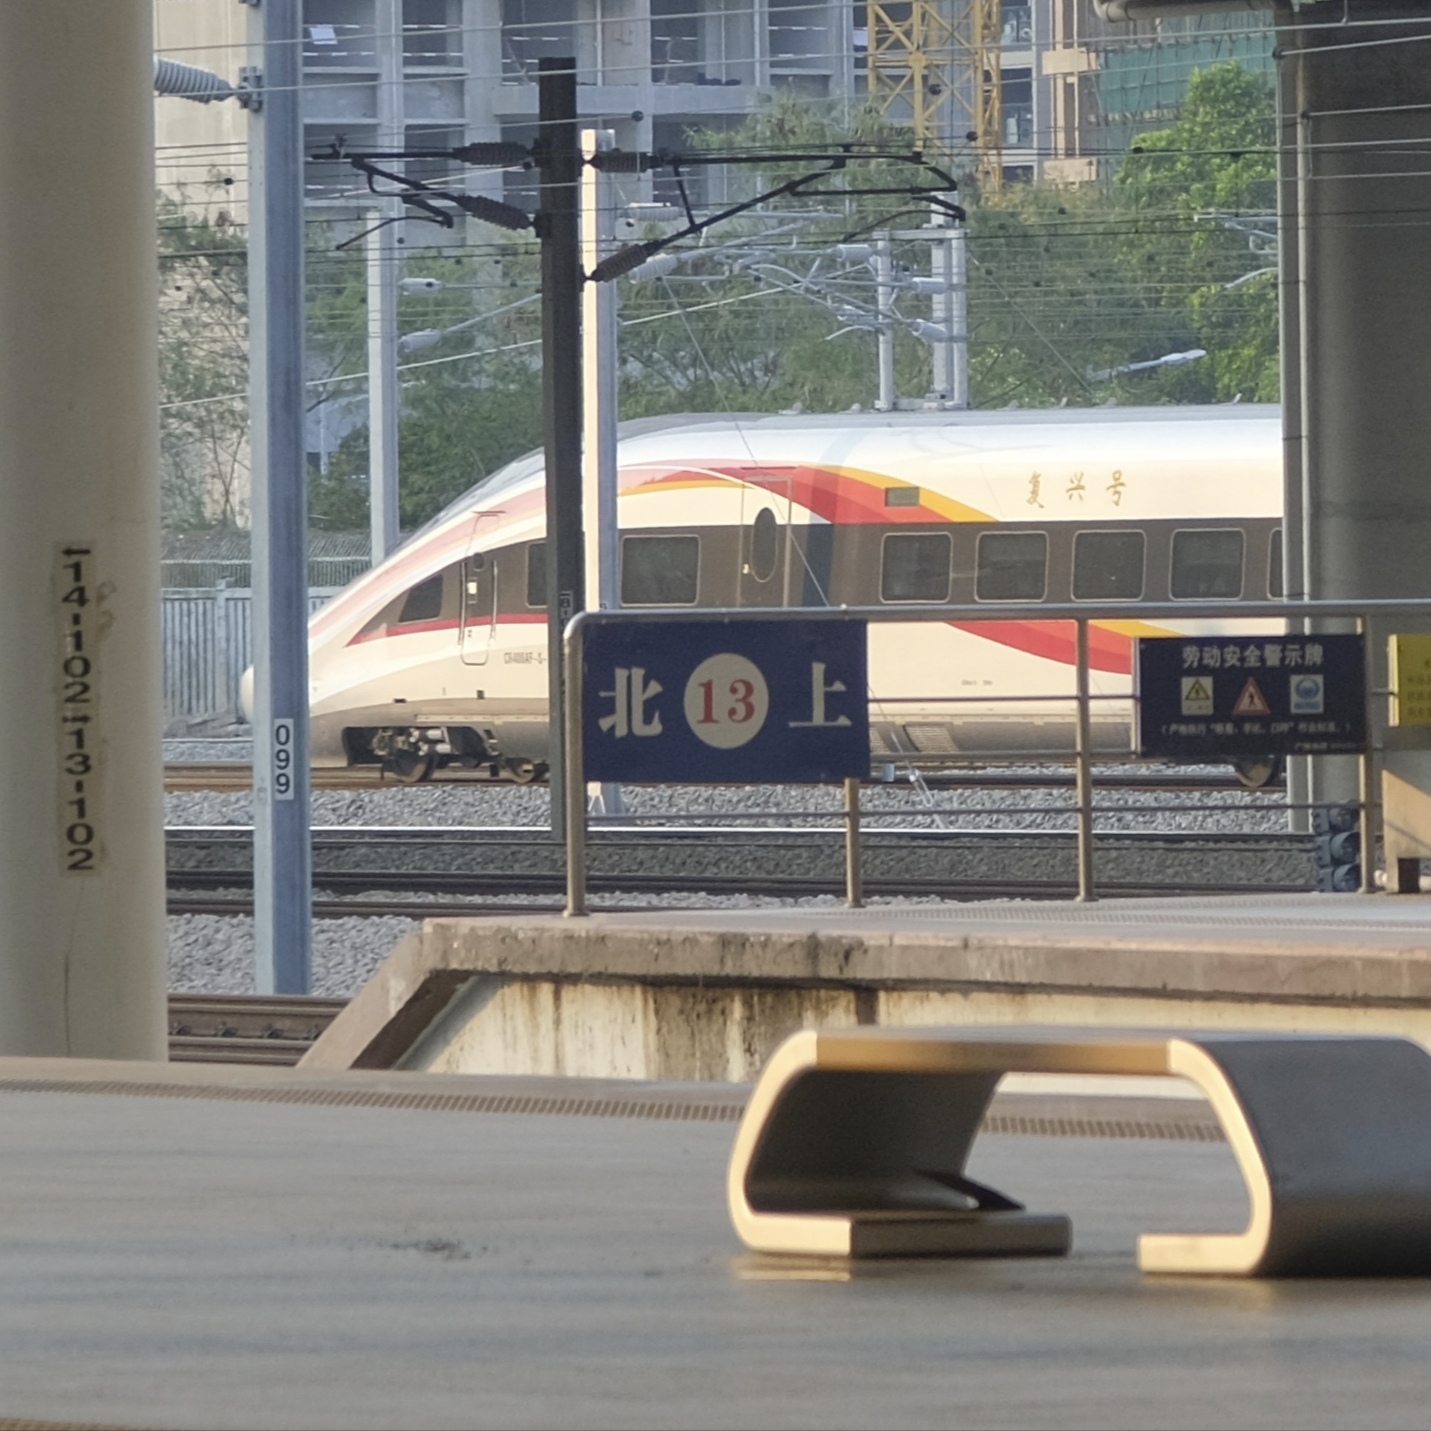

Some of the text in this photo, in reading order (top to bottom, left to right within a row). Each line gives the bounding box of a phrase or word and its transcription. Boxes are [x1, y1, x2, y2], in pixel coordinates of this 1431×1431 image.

[1181, 643, 1324, 668] 劳动安全警示牌
[598, 661, 853, 739] 北 13 上
[275, 724, 290, 794] 099
